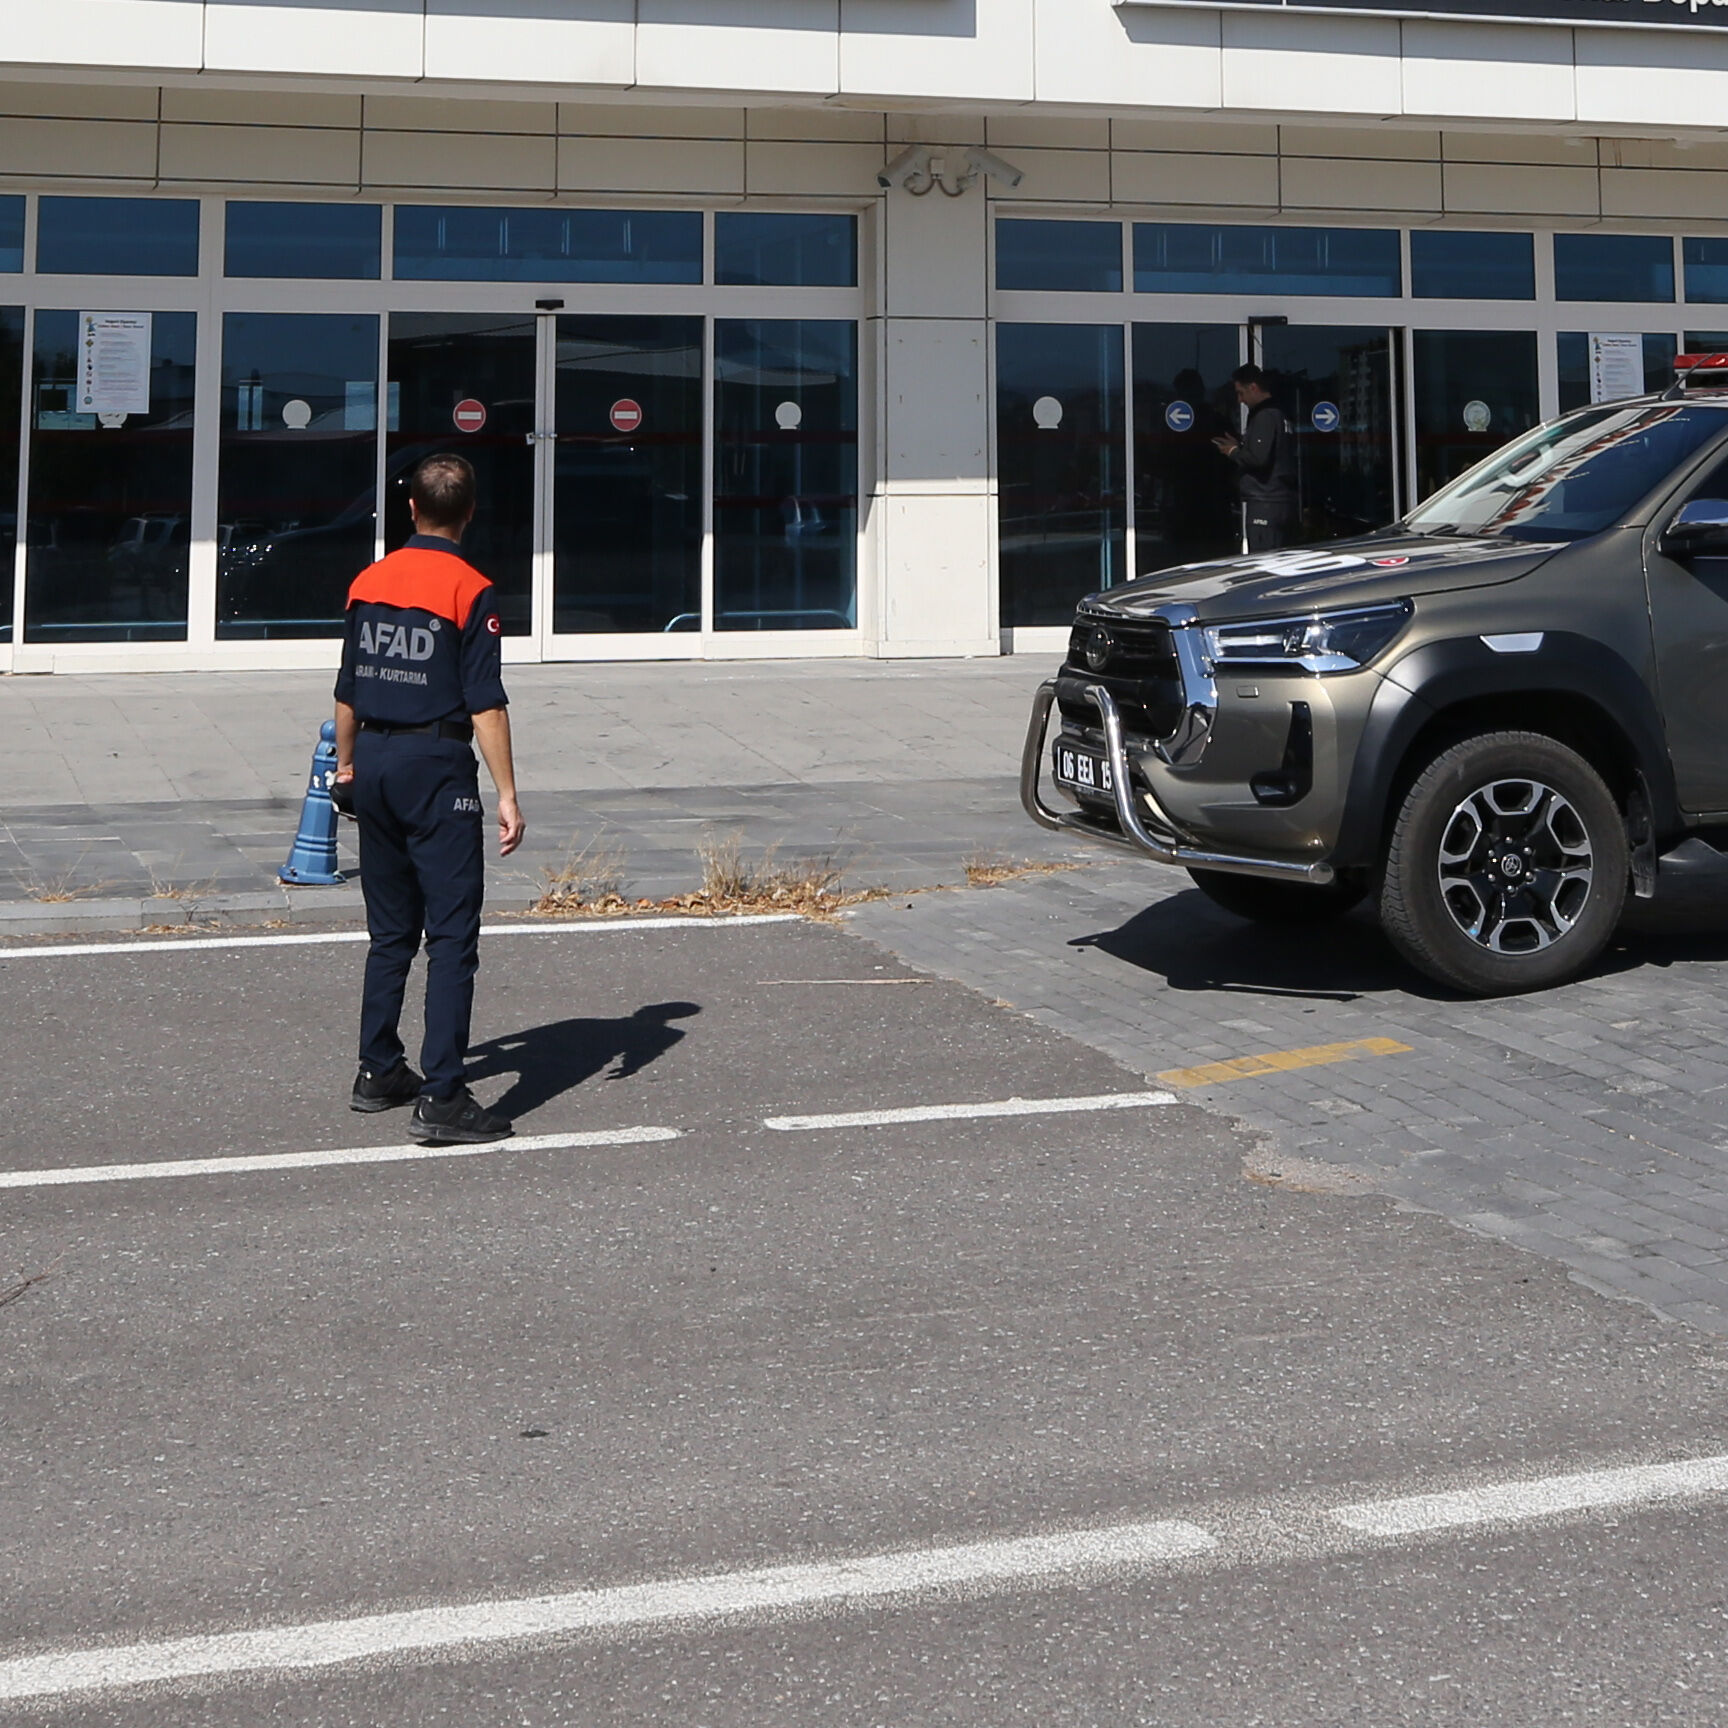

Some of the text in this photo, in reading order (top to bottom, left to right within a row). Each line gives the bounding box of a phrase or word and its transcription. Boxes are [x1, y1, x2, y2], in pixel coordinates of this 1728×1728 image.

[359, 620, 435, 661] AFAD
[379, 667, 428, 686] KURTARMA
[1063, 750, 1074, 779] 06
[1077, 754, 1095, 785] EEA
